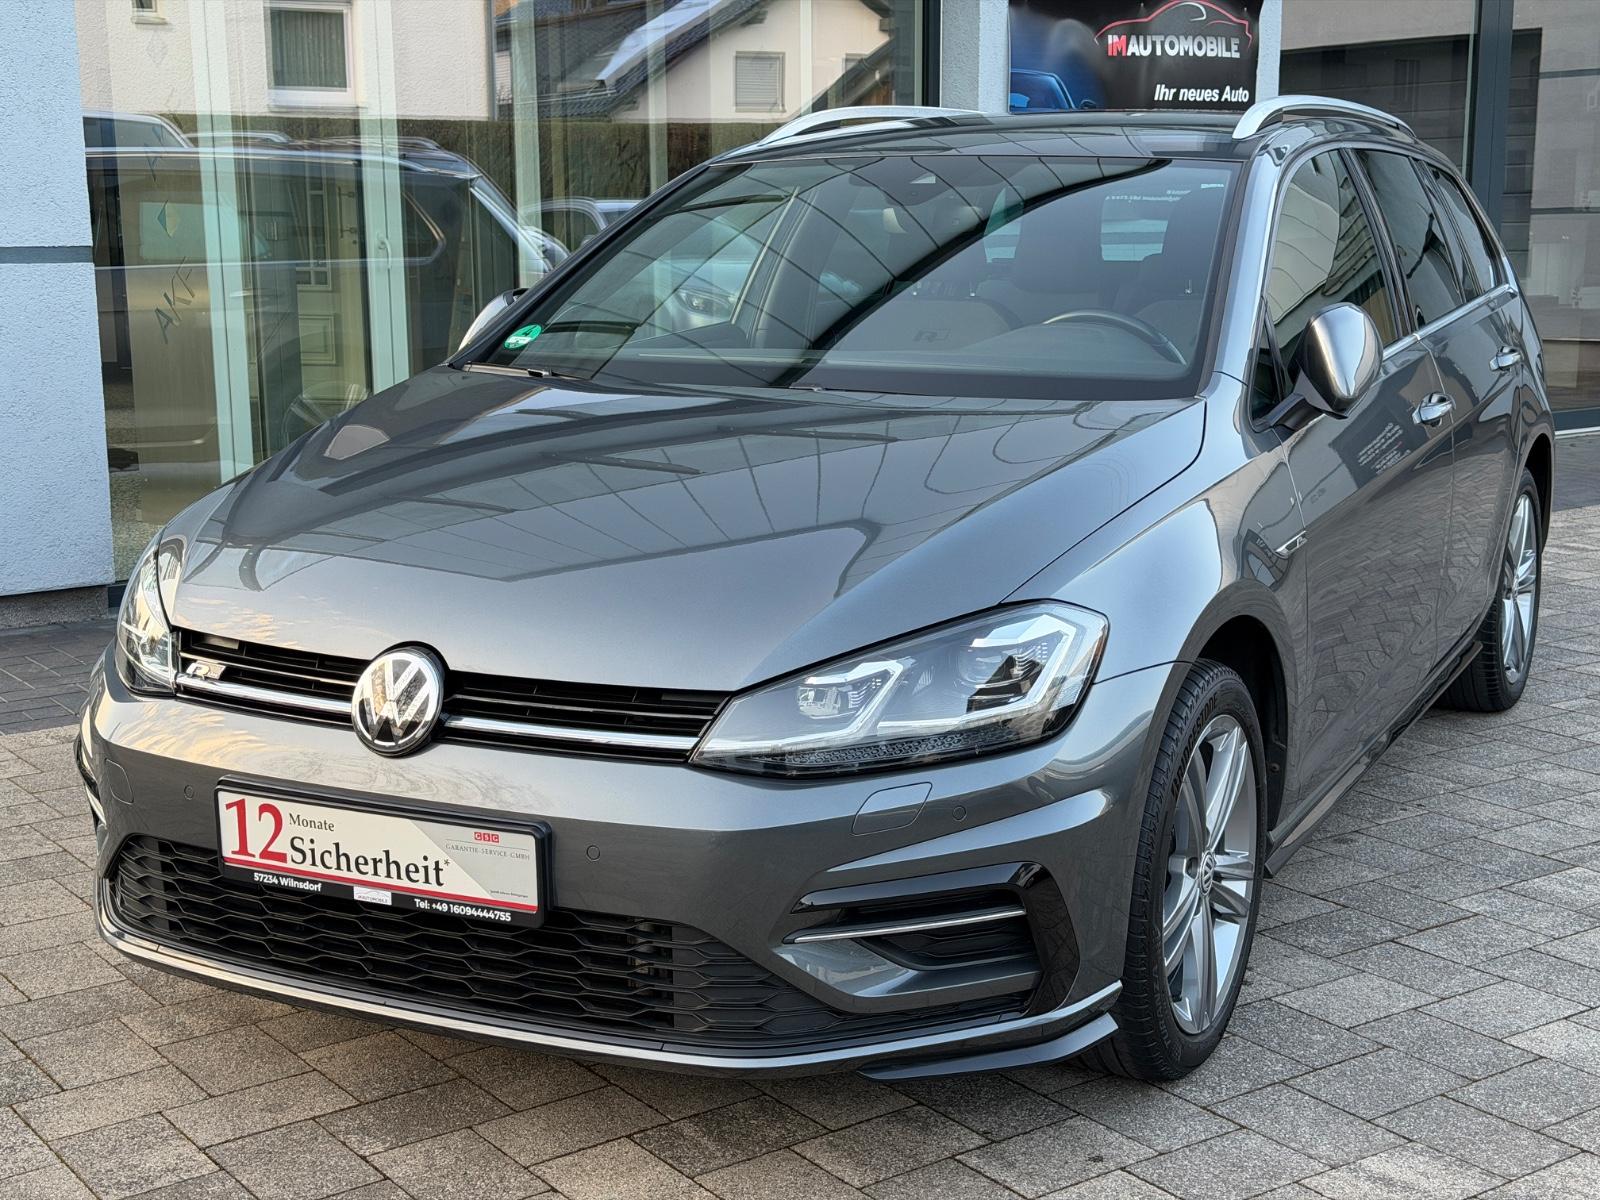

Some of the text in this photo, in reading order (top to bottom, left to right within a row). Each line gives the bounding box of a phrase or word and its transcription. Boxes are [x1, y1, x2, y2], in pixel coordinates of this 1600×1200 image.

[1107, 34, 1241, 58] IMAUTOMOBILE
[1154, 84, 1250, 103] Ihr neues Auto
[225, 798, 288, 865] 12
[289, 812, 335, 832] Monate
[253, 872, 321, 891] 57234 Wilnsdorf
[414, 898, 512, 922] Tel: +49 16094444755
